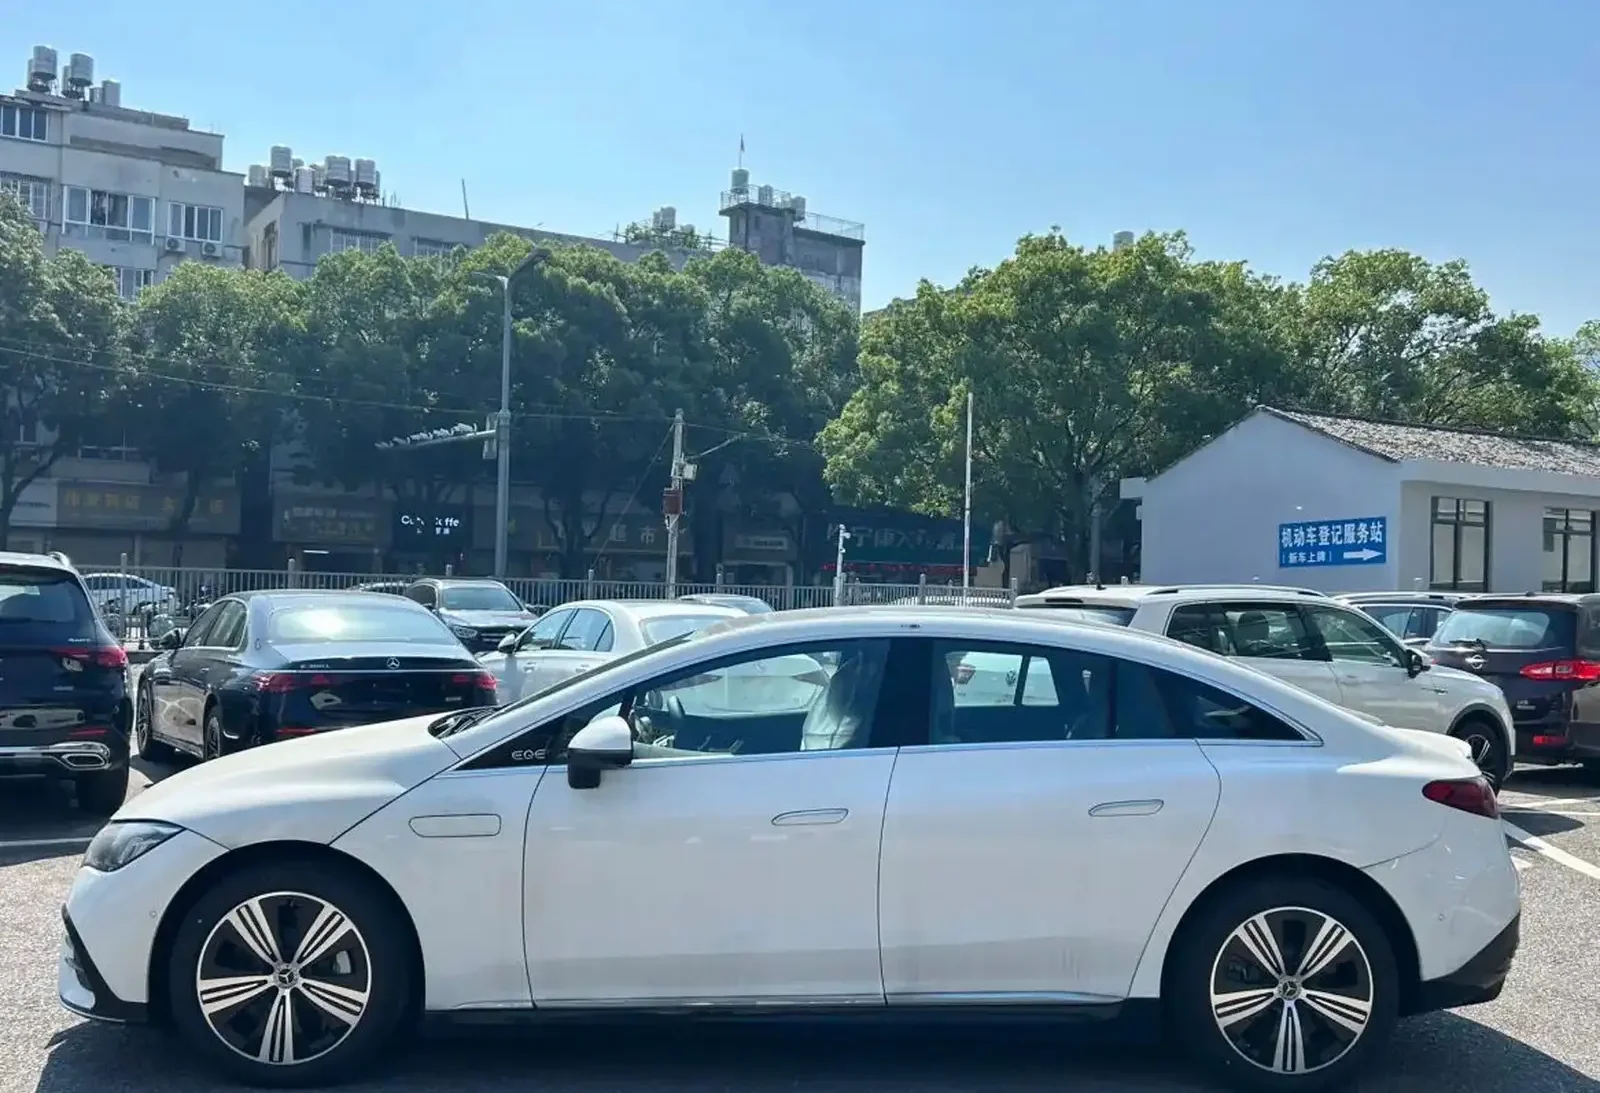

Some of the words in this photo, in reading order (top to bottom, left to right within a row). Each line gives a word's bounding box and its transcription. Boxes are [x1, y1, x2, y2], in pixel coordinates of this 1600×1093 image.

[1281, 520, 1384, 548] 机动车登记服务站
[511, 748, 546, 761] EQE
